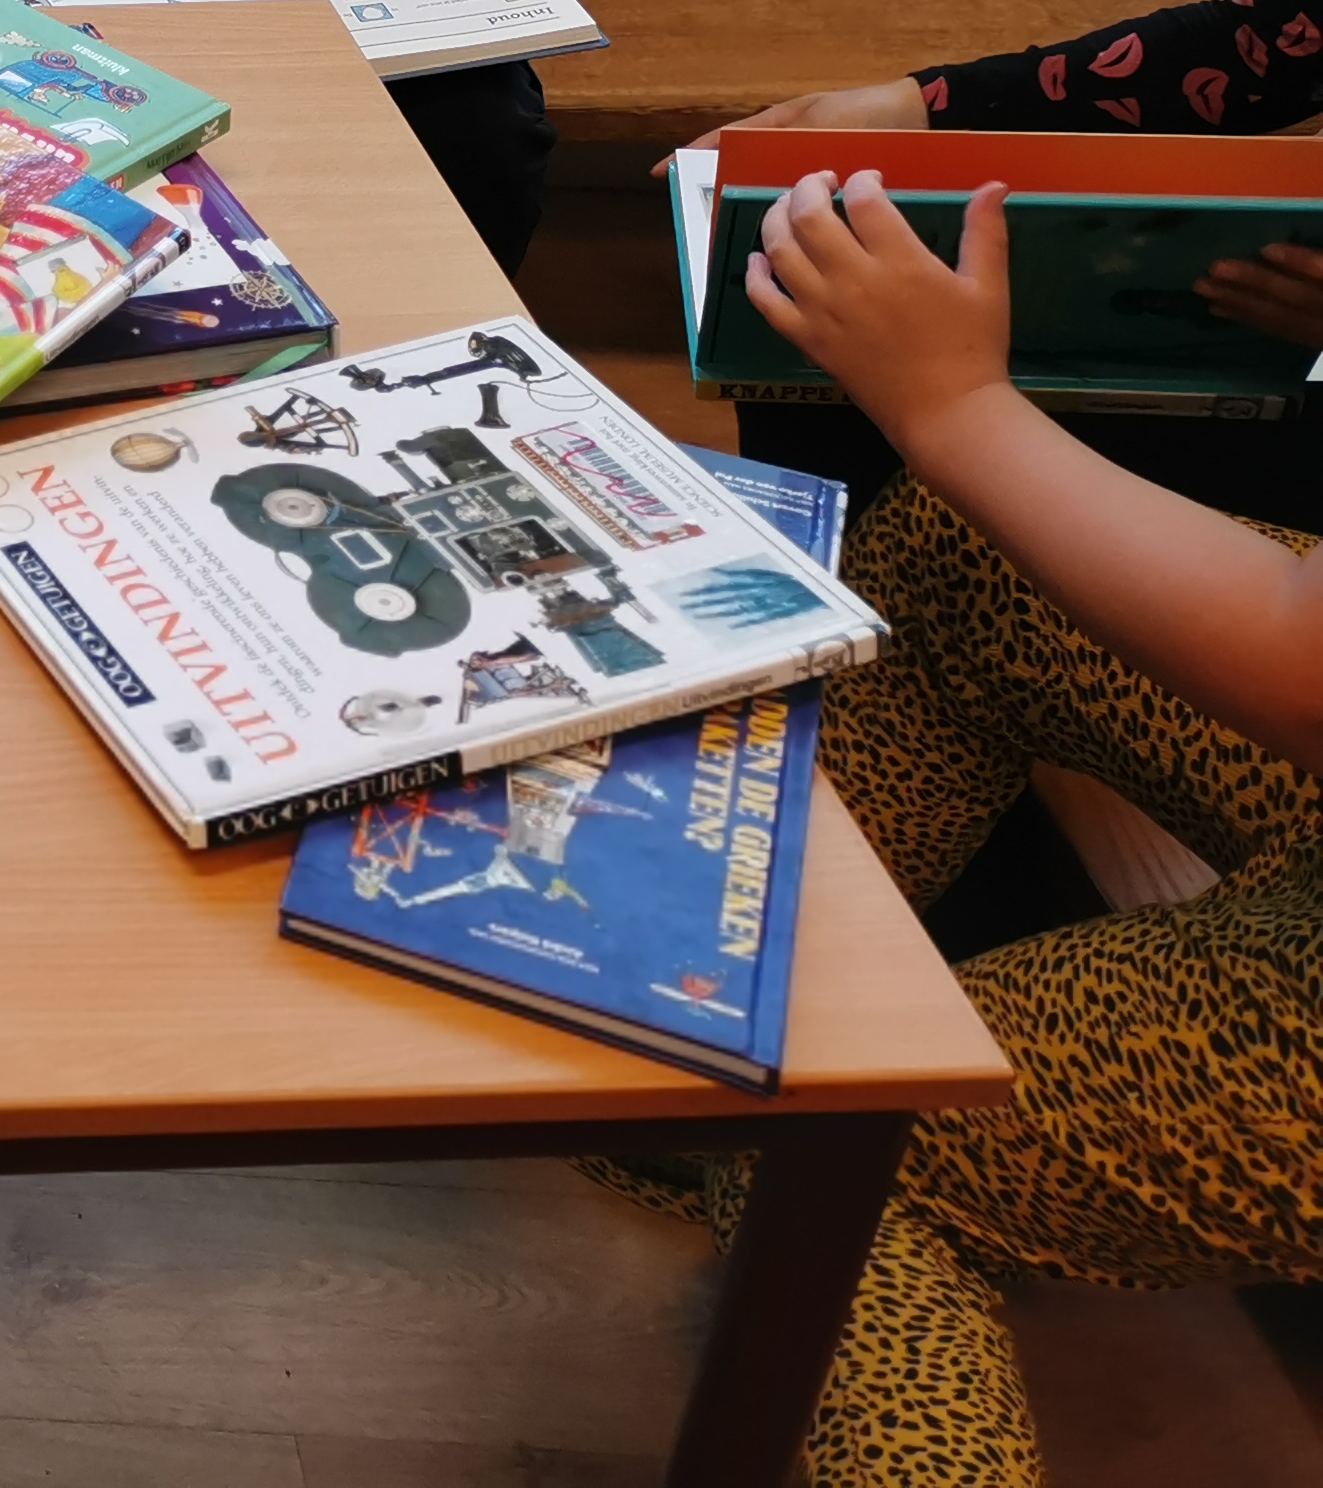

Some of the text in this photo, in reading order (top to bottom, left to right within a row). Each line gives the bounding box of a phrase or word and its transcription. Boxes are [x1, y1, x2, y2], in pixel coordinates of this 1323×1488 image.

[486, 5, 556, 28] Inhoud
[719, 383, 836, 402] KNAPPE
[600, 414, 646, 449] LONDEN
[136, 497, 173, 538] werken
[146, 488, 195, 540] veranderd
[679, 478, 721, 518] SCIENCE
[130, 520, 150, 541] van
[194, 539, 225, 570] hebben
[226, 569, 255, 600] leven
[11, 549, 143, 698] OOG GETUIGEN
[16, 464, 299, 765] UITVINDINGEN
[252, 601, 272, 620] ons
[254, 632, 278, 656] hun
[282, 635, 322, 677] waarom
[270, 678, 311, 720] Ontdek
[680, 673, 775, 711] Uitvindingen
[216, 757, 452, 842] OOG GETUIGEN
[717, 774, 780, 963] DE GRIEKEN
